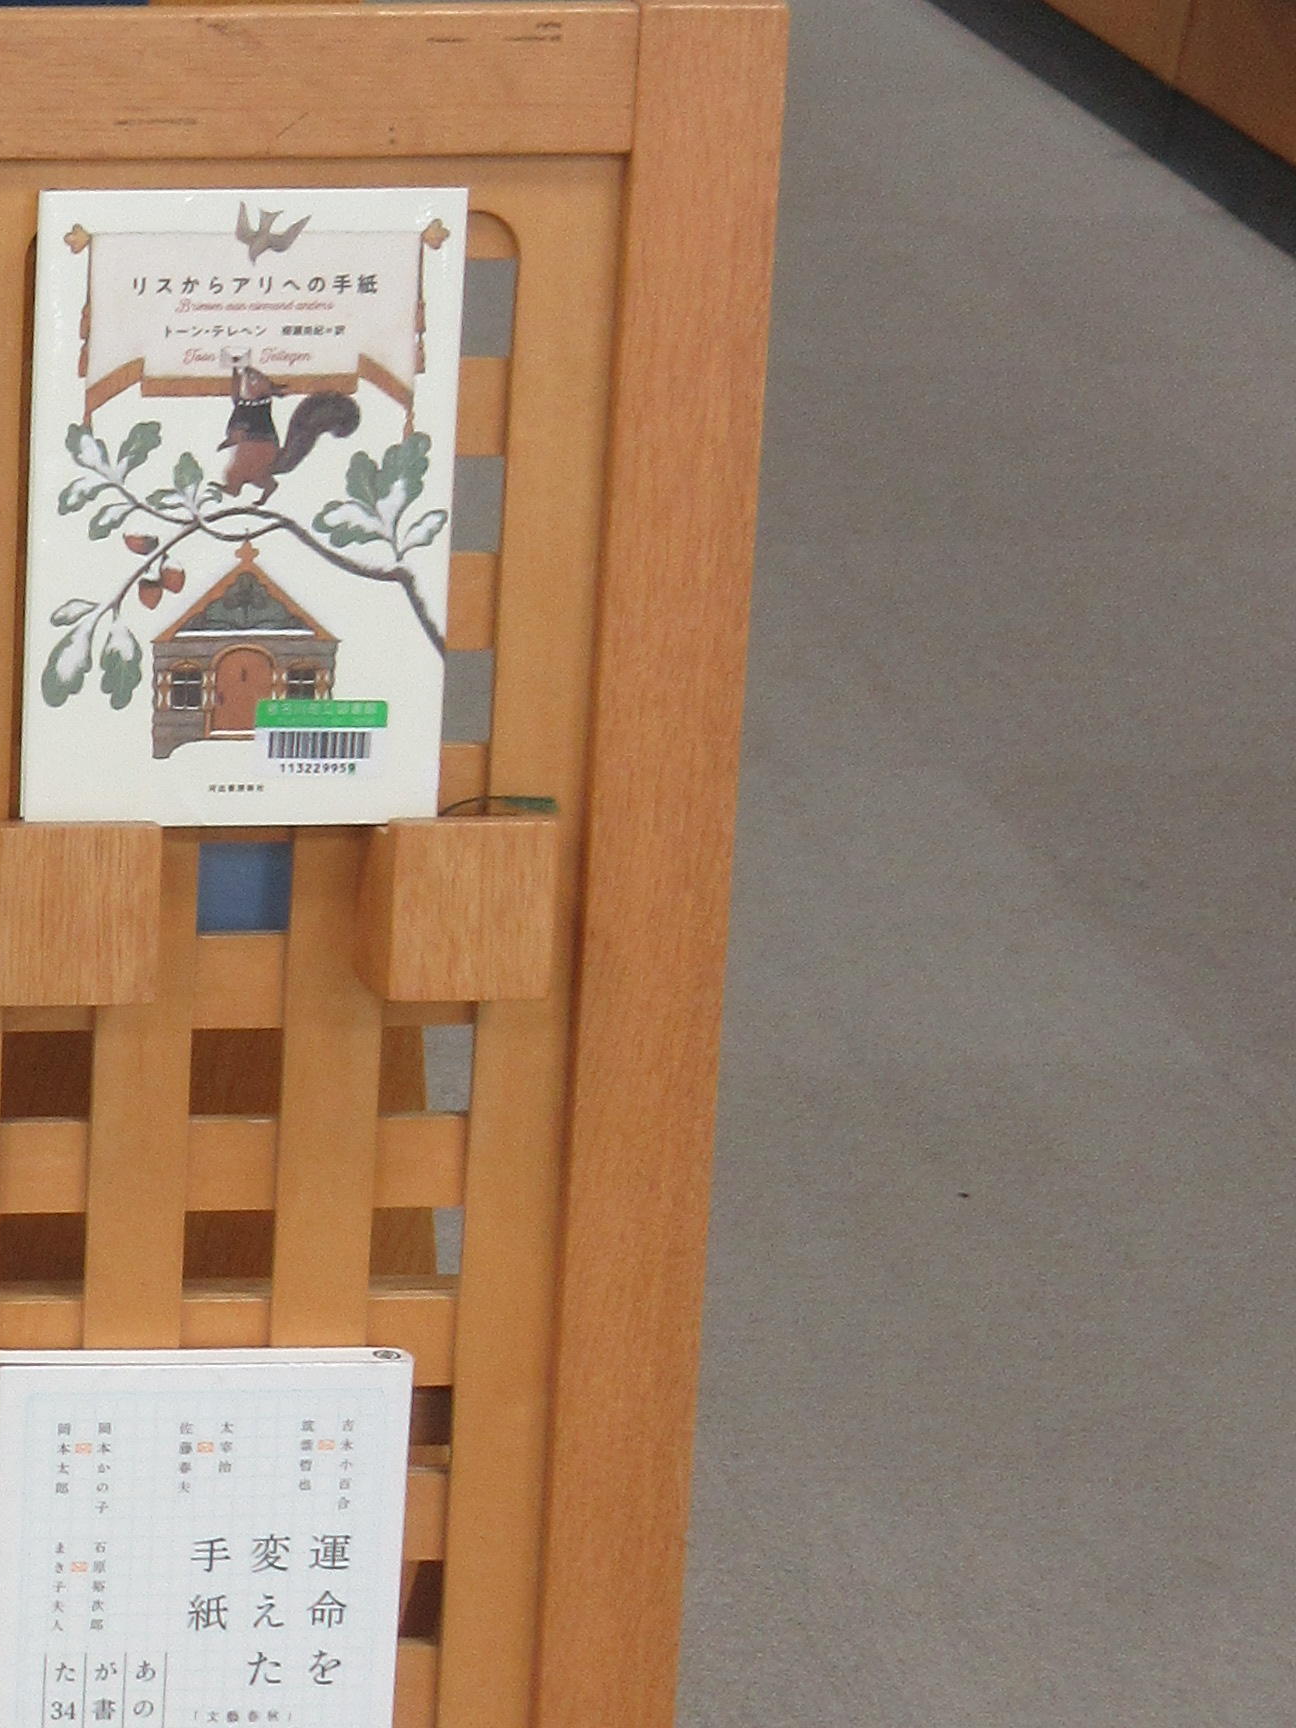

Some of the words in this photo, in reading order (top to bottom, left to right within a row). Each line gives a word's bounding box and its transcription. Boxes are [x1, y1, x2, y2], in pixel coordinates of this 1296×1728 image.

[132, 274, 378, 296] リスからアリへの手紙
[164, 325, 267, 338] トーン・テレヘン
[280, 763, 356, 775] 113229959
[55, 1423, 71, 1494] 岡本太郎
[95, 1422, 112, 1514] 岡本かの子
[219, 1422, 234, 1474] 太宰治
[188, 1537, 231, 1632] 手紙
[247, 1535, 291, 1687] 変えた
[306, 1533, 351, 1687] 運命を
